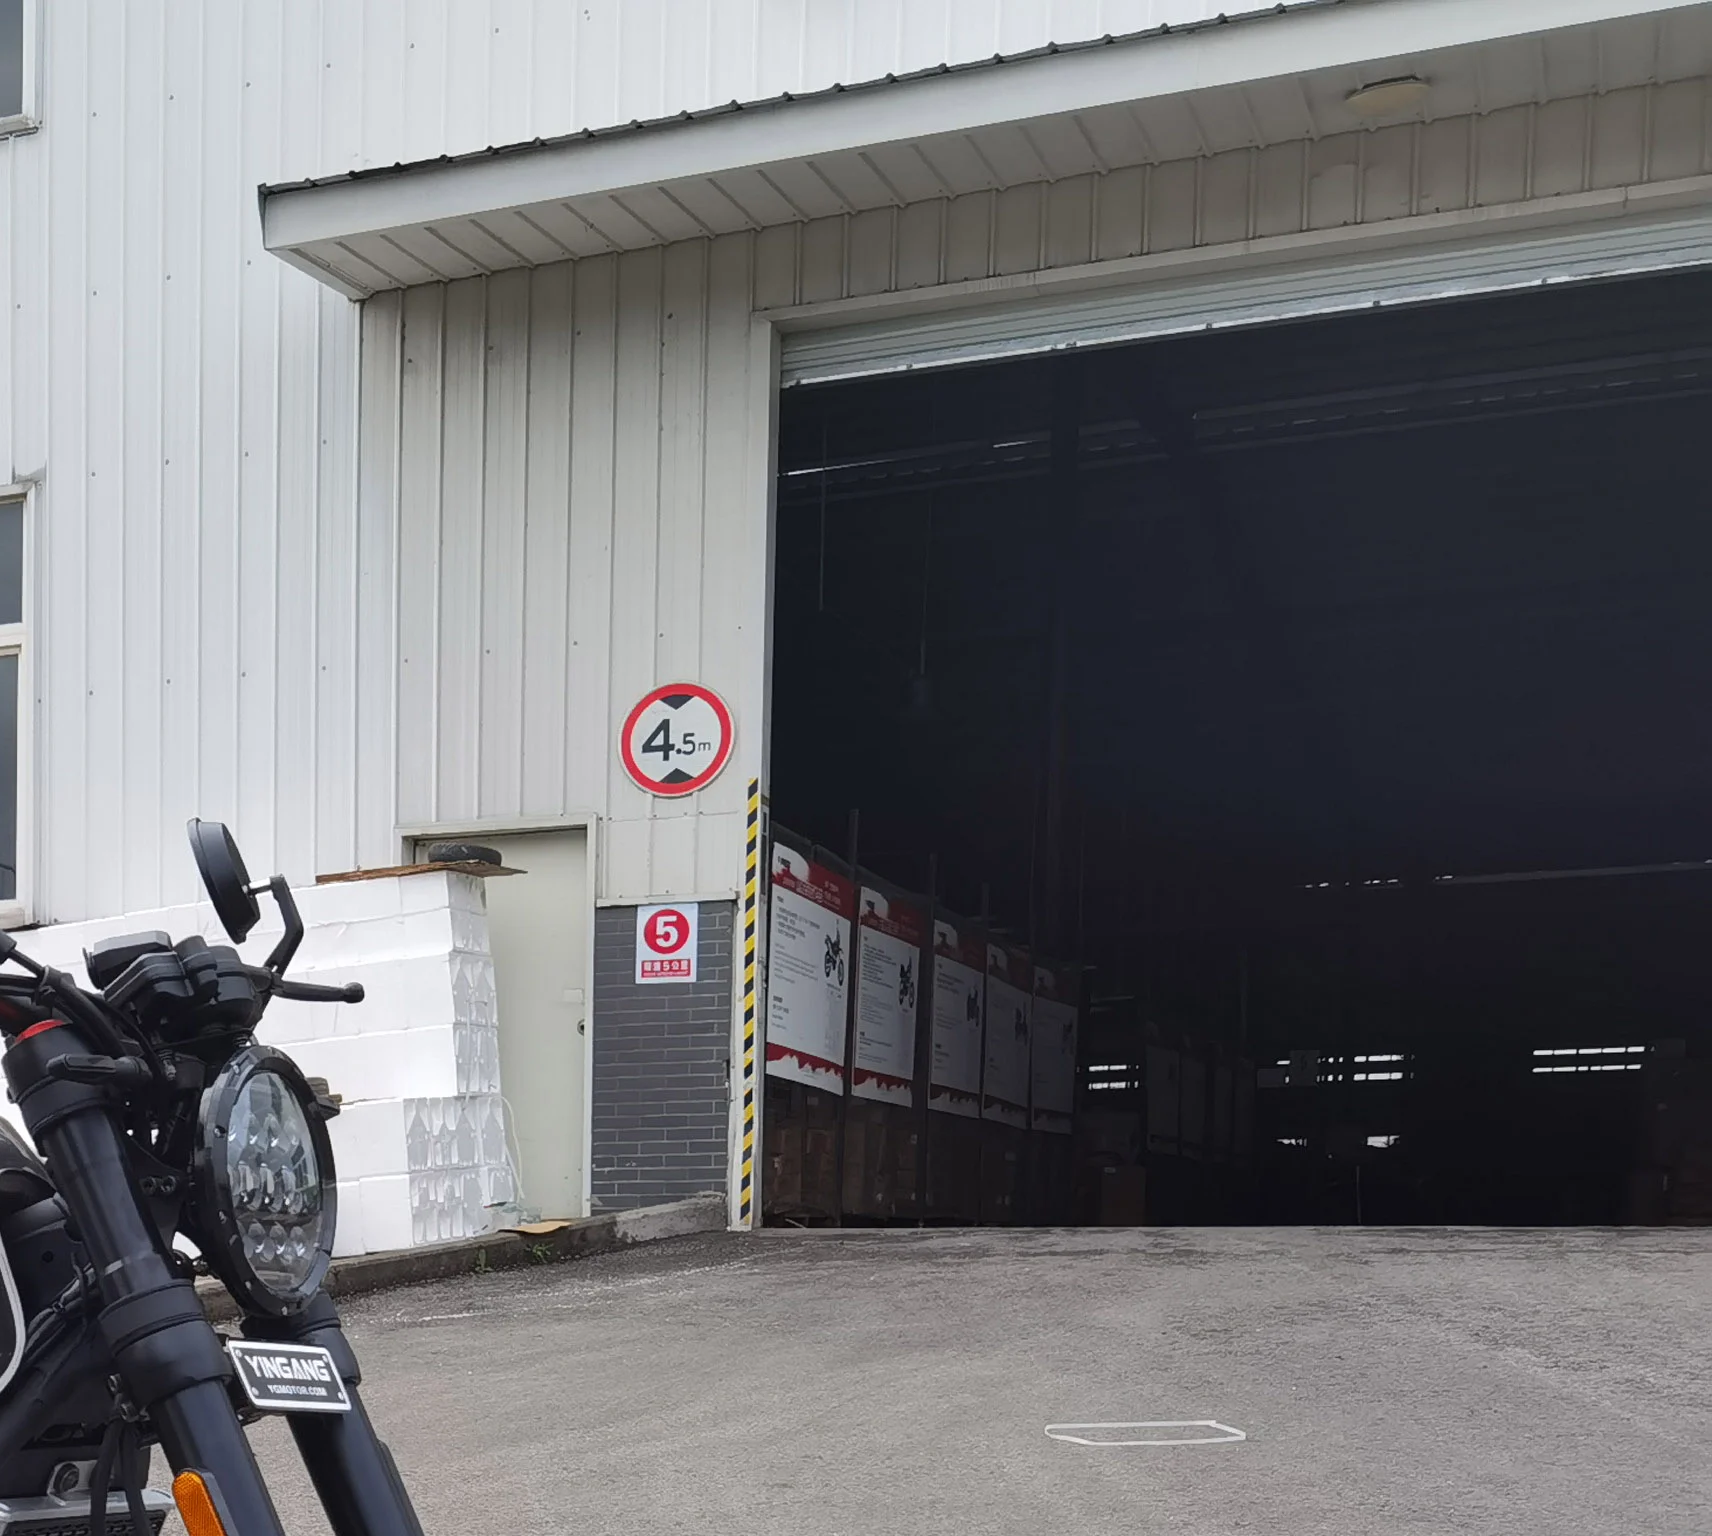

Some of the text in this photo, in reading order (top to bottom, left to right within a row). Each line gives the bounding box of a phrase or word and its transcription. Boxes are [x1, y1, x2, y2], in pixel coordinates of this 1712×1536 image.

[641, 718, 711, 762] 4.5m
[656, 915, 679, 948] 5
[244, 1355, 332, 1382] YINGANG
